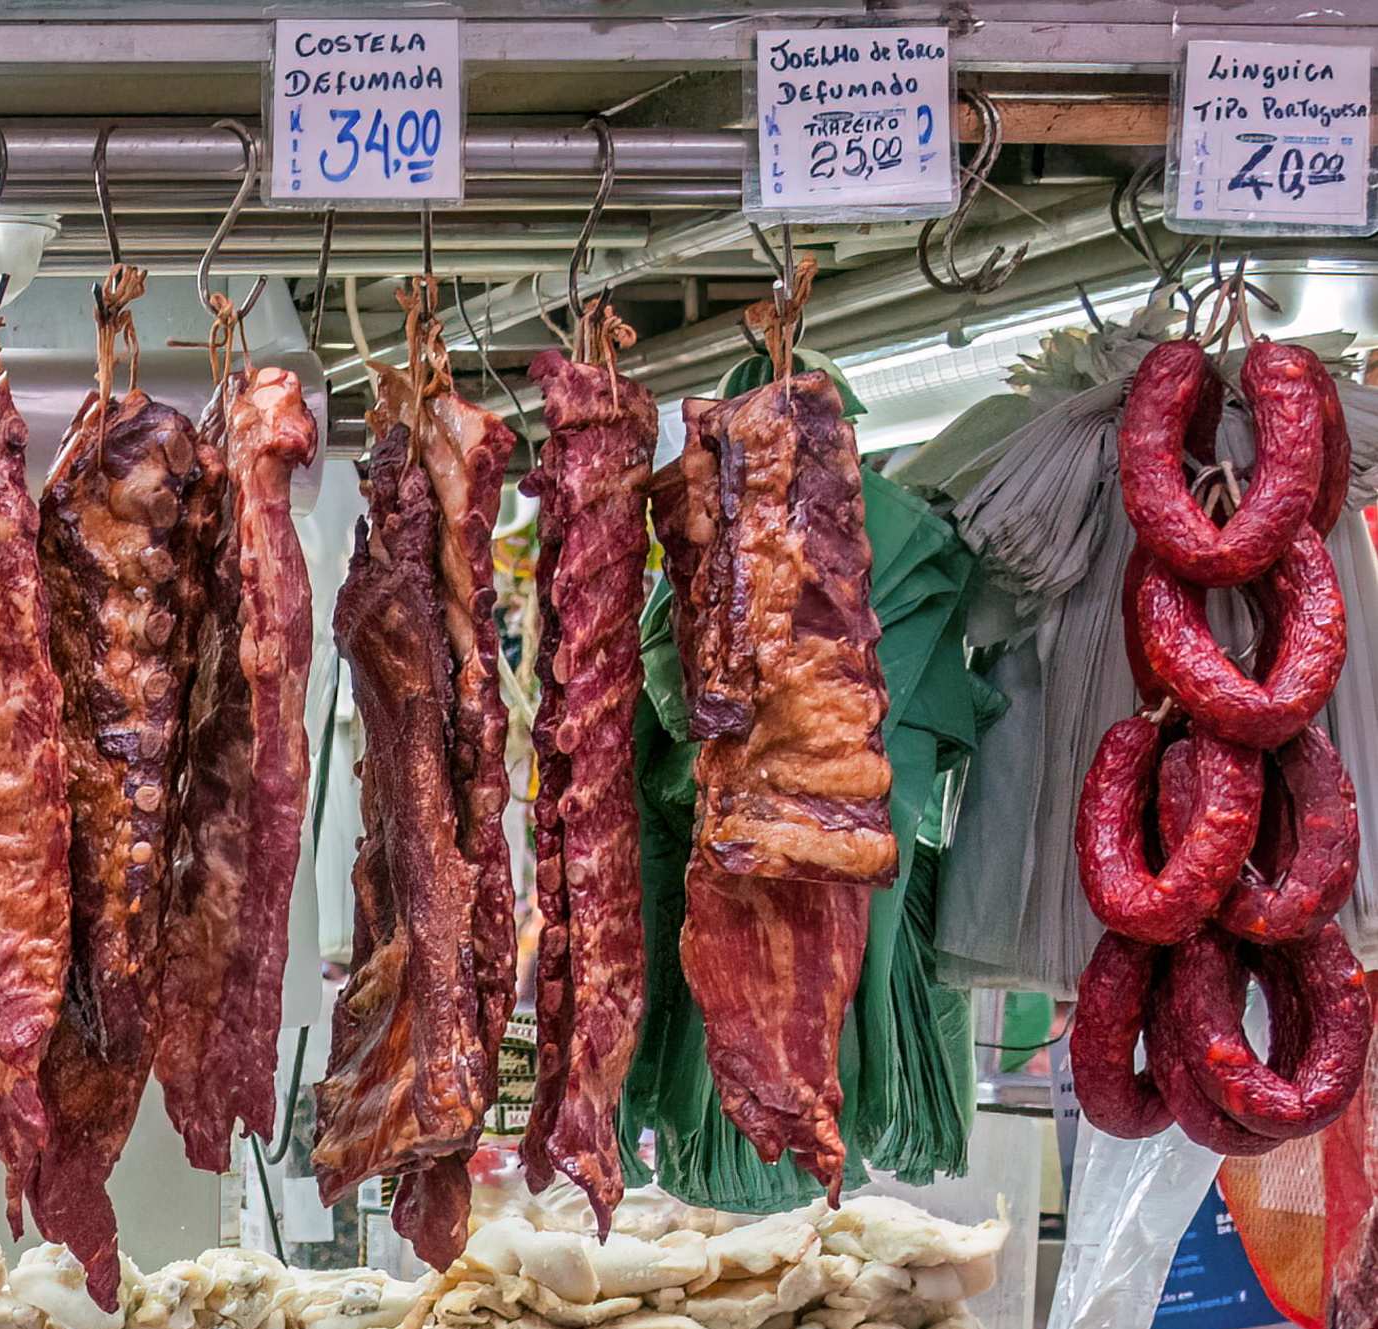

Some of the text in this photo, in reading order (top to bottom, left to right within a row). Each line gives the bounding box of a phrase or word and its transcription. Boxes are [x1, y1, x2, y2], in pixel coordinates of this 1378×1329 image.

[295, 32, 425, 57] COSTELA
[770, 39, 859, 72] JOELHO
[290, 103, 304, 191] KILO
[319, 108, 441, 183] 34,00
[765, 105, 785, 194] KILO
[809, 136, 902, 180] 25,00
